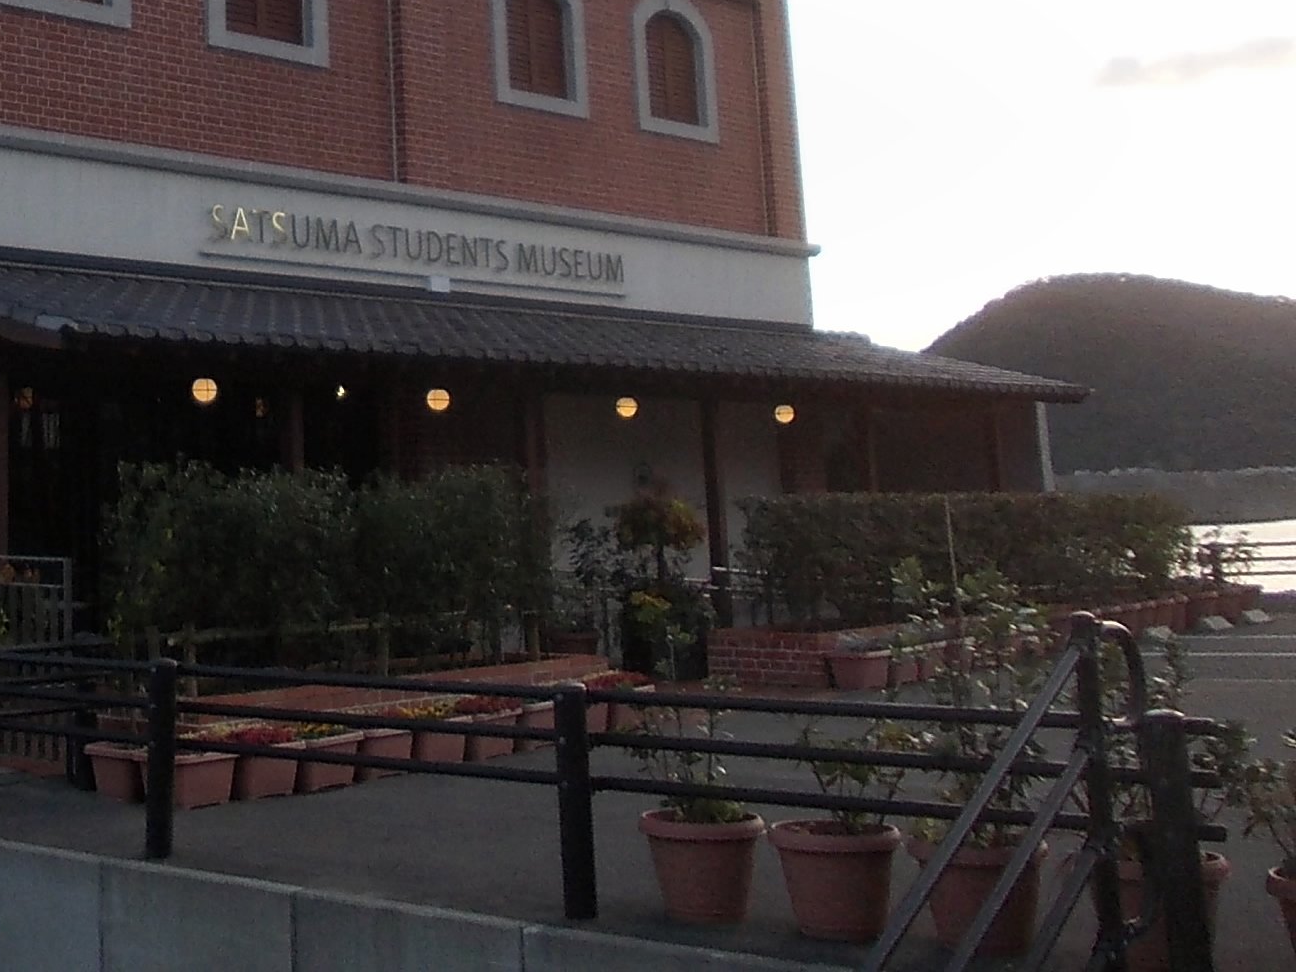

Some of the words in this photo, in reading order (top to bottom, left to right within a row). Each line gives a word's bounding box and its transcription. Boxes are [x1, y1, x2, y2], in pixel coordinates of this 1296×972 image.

[209, 203, 363, 255] SATSUMA
[370, 223, 510, 271] STUDENTS
[517, 241, 625, 283] MUSEUM
